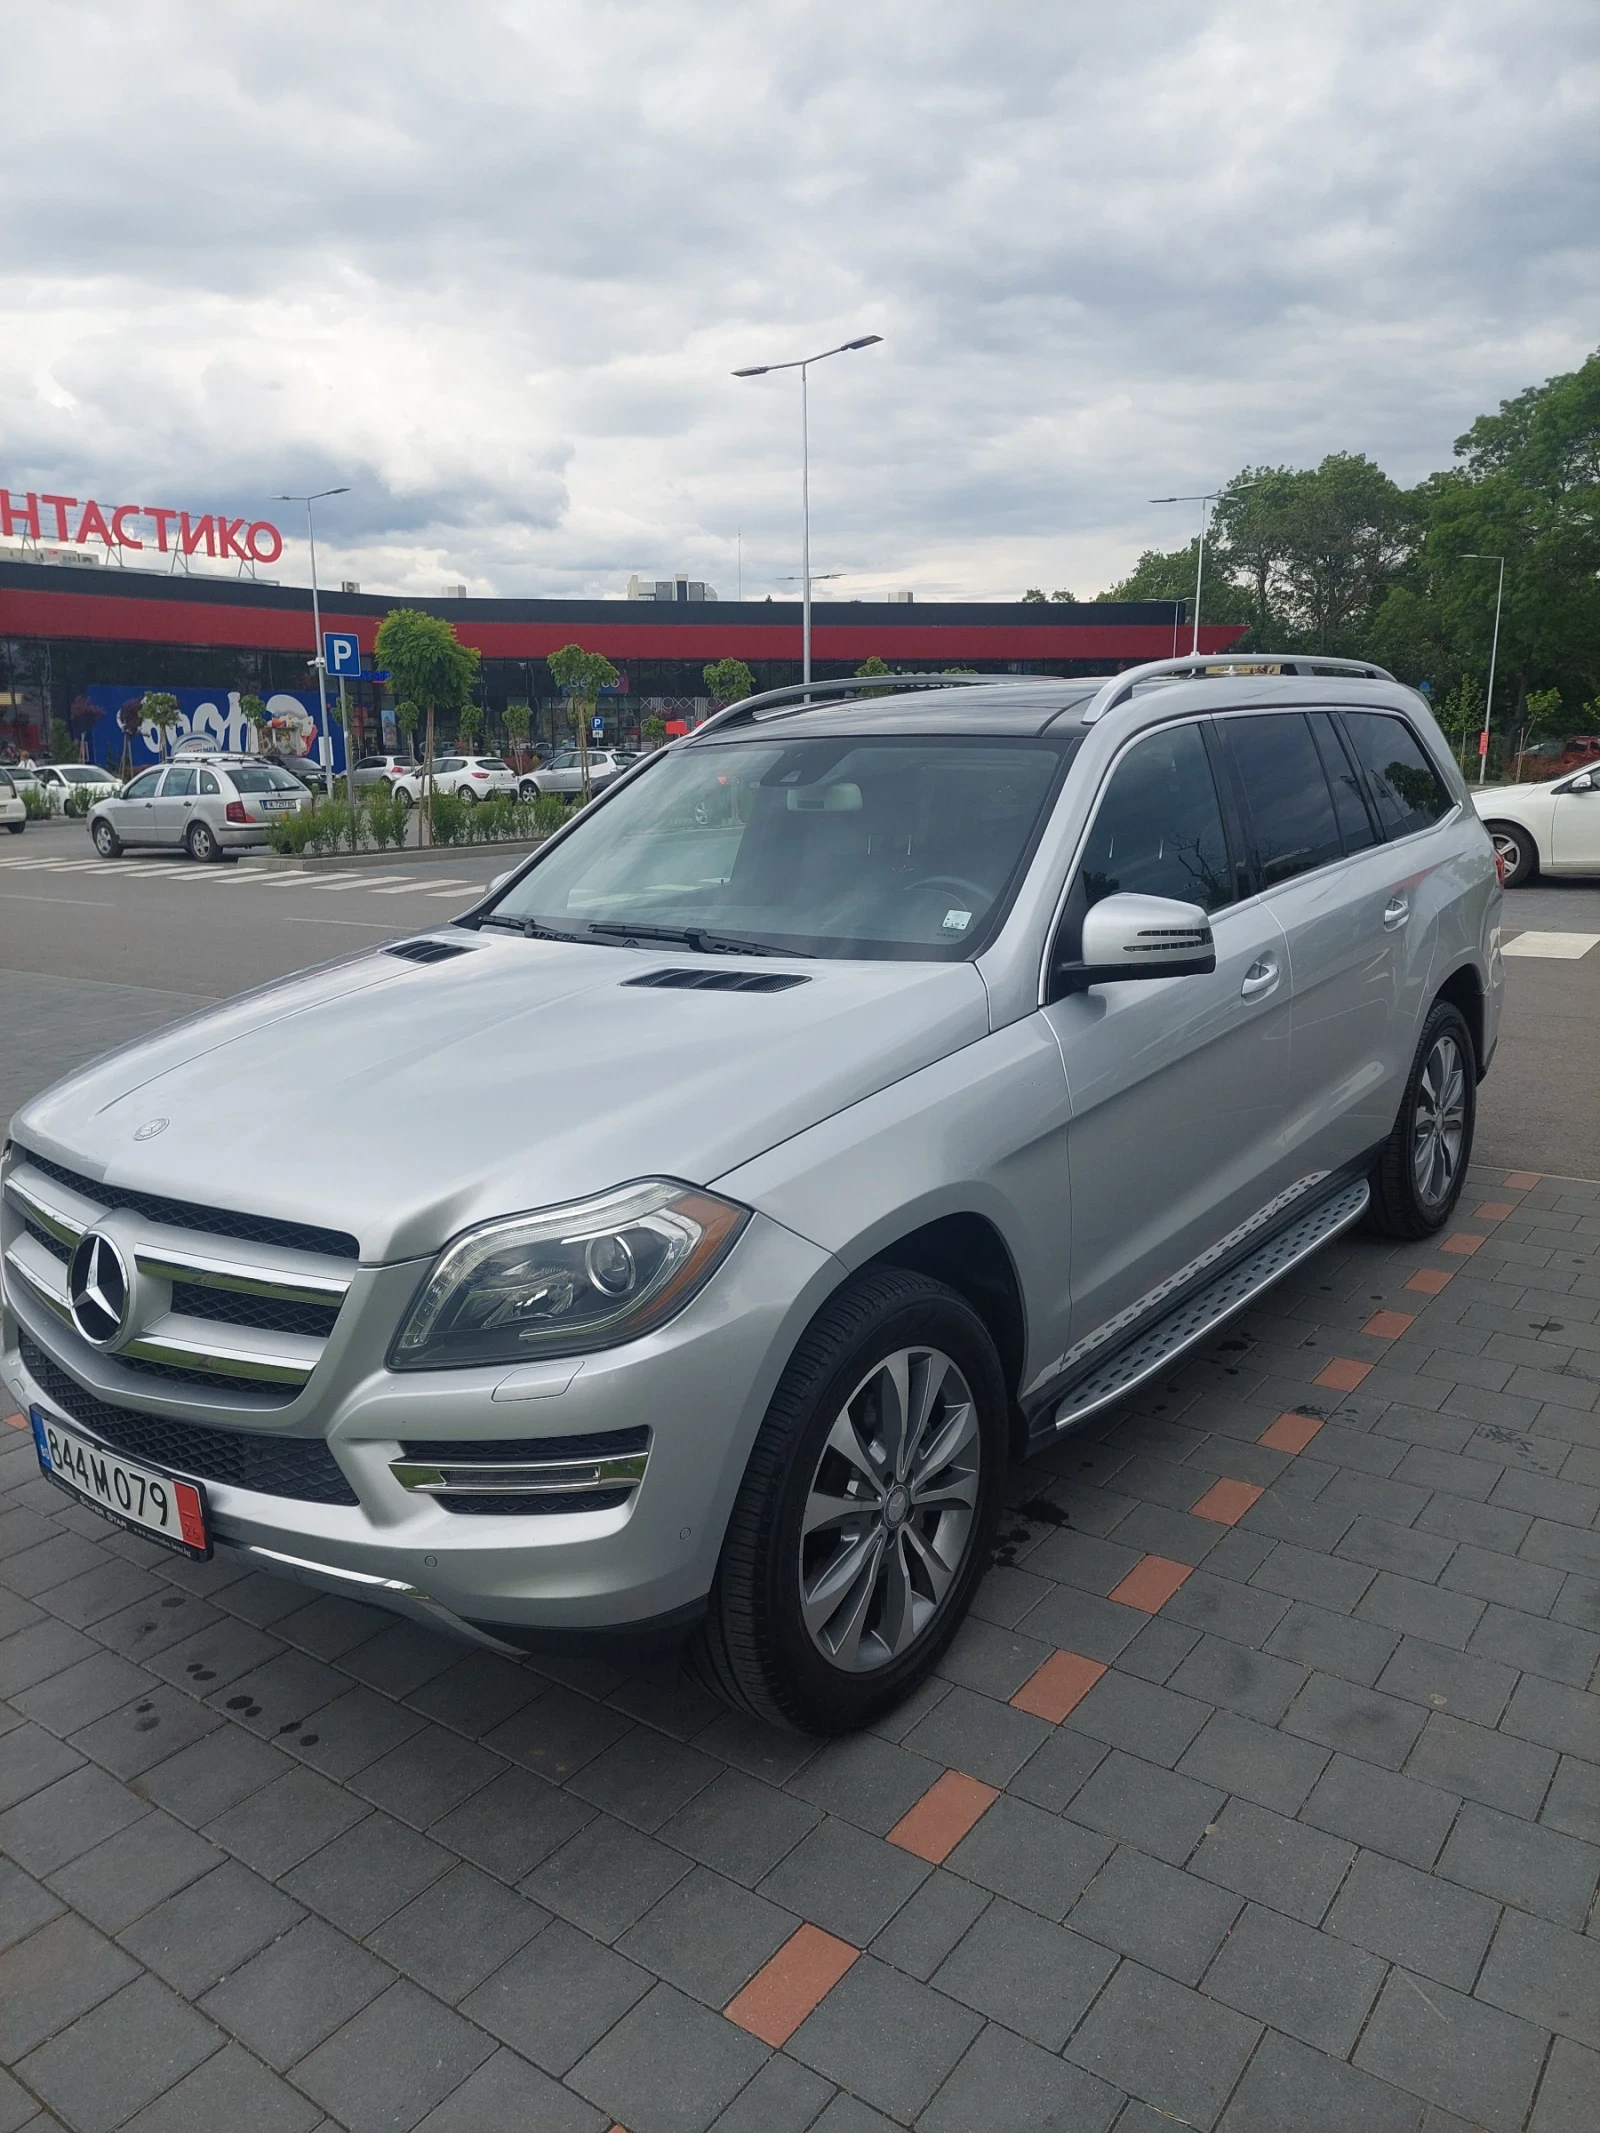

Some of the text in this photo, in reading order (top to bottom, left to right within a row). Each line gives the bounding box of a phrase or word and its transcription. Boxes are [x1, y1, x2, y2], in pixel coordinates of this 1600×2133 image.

[333, 640, 352, 670] P
[593, 718, 602, 730] P
[47, 1428, 168, 1527] 844M079
